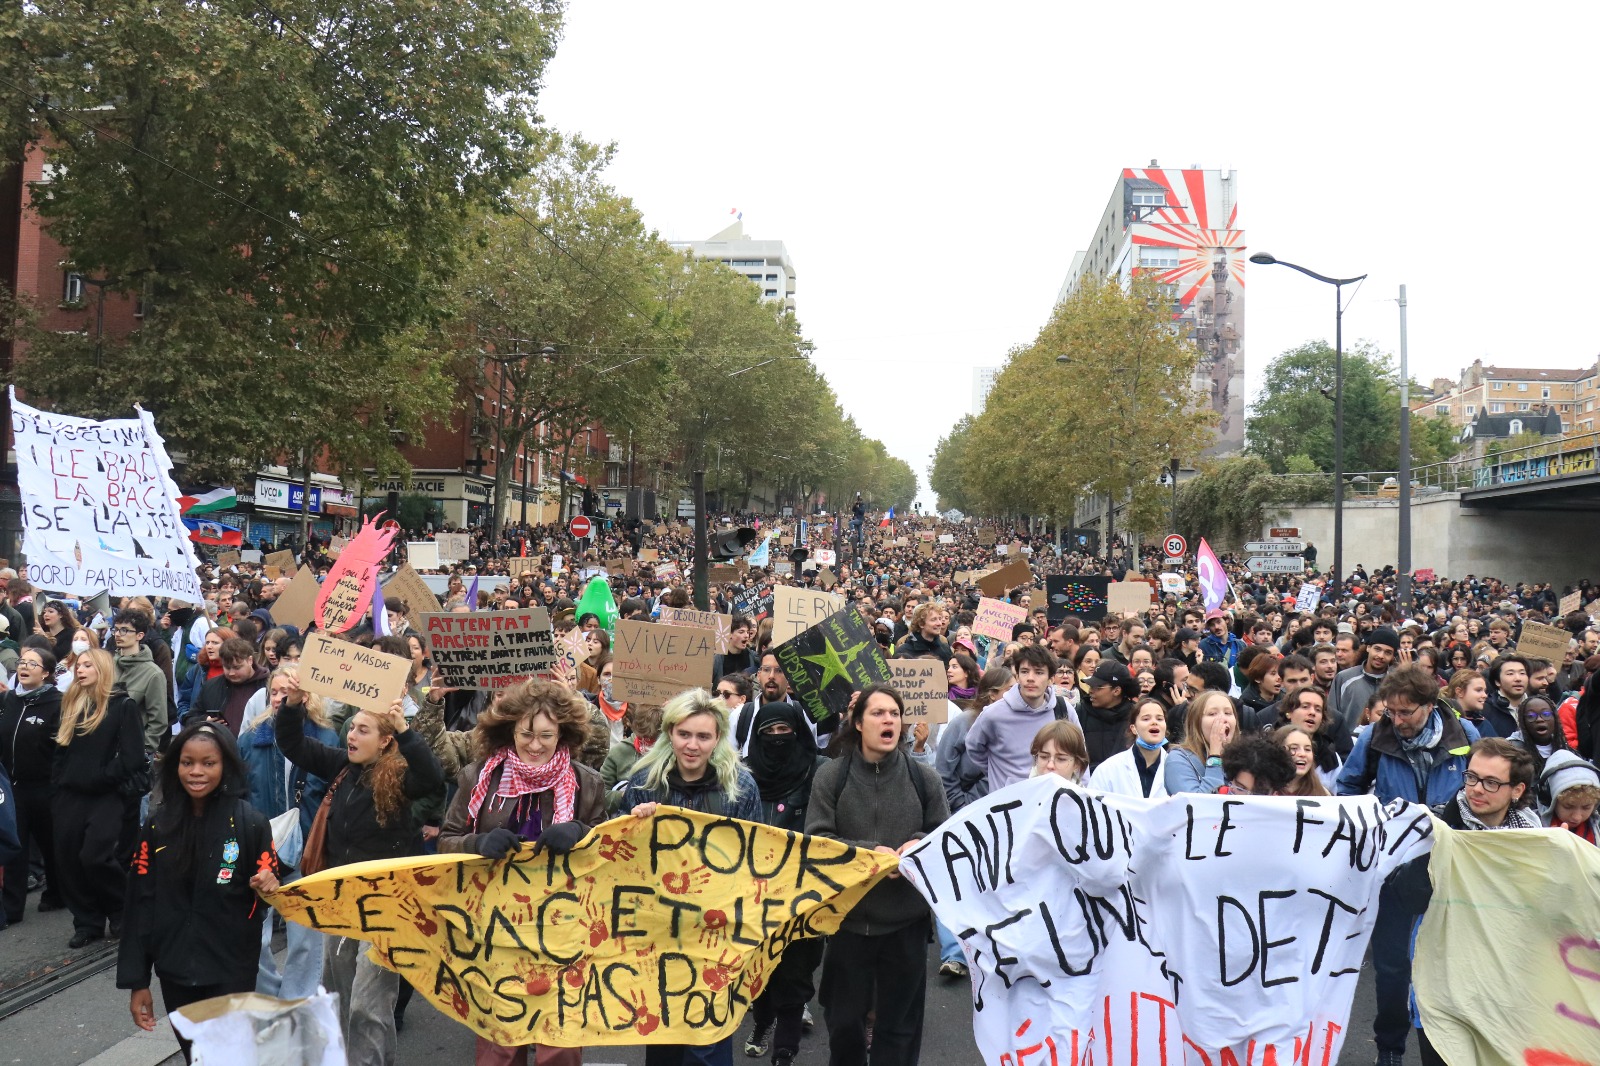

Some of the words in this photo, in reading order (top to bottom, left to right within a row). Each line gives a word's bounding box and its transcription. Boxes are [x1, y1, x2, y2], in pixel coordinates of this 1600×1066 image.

[50, 447, 88, 479] LE
[103, 451, 155, 484] BAC
[54, 478, 94, 502] LA
[107, 483, 155, 510] BAC
[260, 483, 278, 498] Lyca
[372, 481, 445, 492] PHARACIE
[93, 508, 133, 534] LA
[1169, 541, 1182, 551] 50
[85, 570, 137, 588] PARIS
[788, 596, 807, 617] LE
[427, 615, 532, 632] ATTENTAT
[492, 631, 506, 647] À
[685, 635, 711, 657] LA
[828, 618, 850, 648] WILL
[854, 662, 876, 688] TUR
[849, 609, 864, 628] THE
[870, 648, 891, 682] WORLD
[778, 645, 814, 691] UPSIDE
[801, 690, 830, 722] DOWN
[919, 667, 933, 677] AN
[136, 841, 149, 875] vivo
[649, 814, 857, 892] POUR
[902, 799, 1022, 904] TANT
[1185, 800, 1244, 860] LE
[305, 893, 396, 933] LE
[611, 884, 702, 940] ET
[556, 962, 640, 1031] PAS
